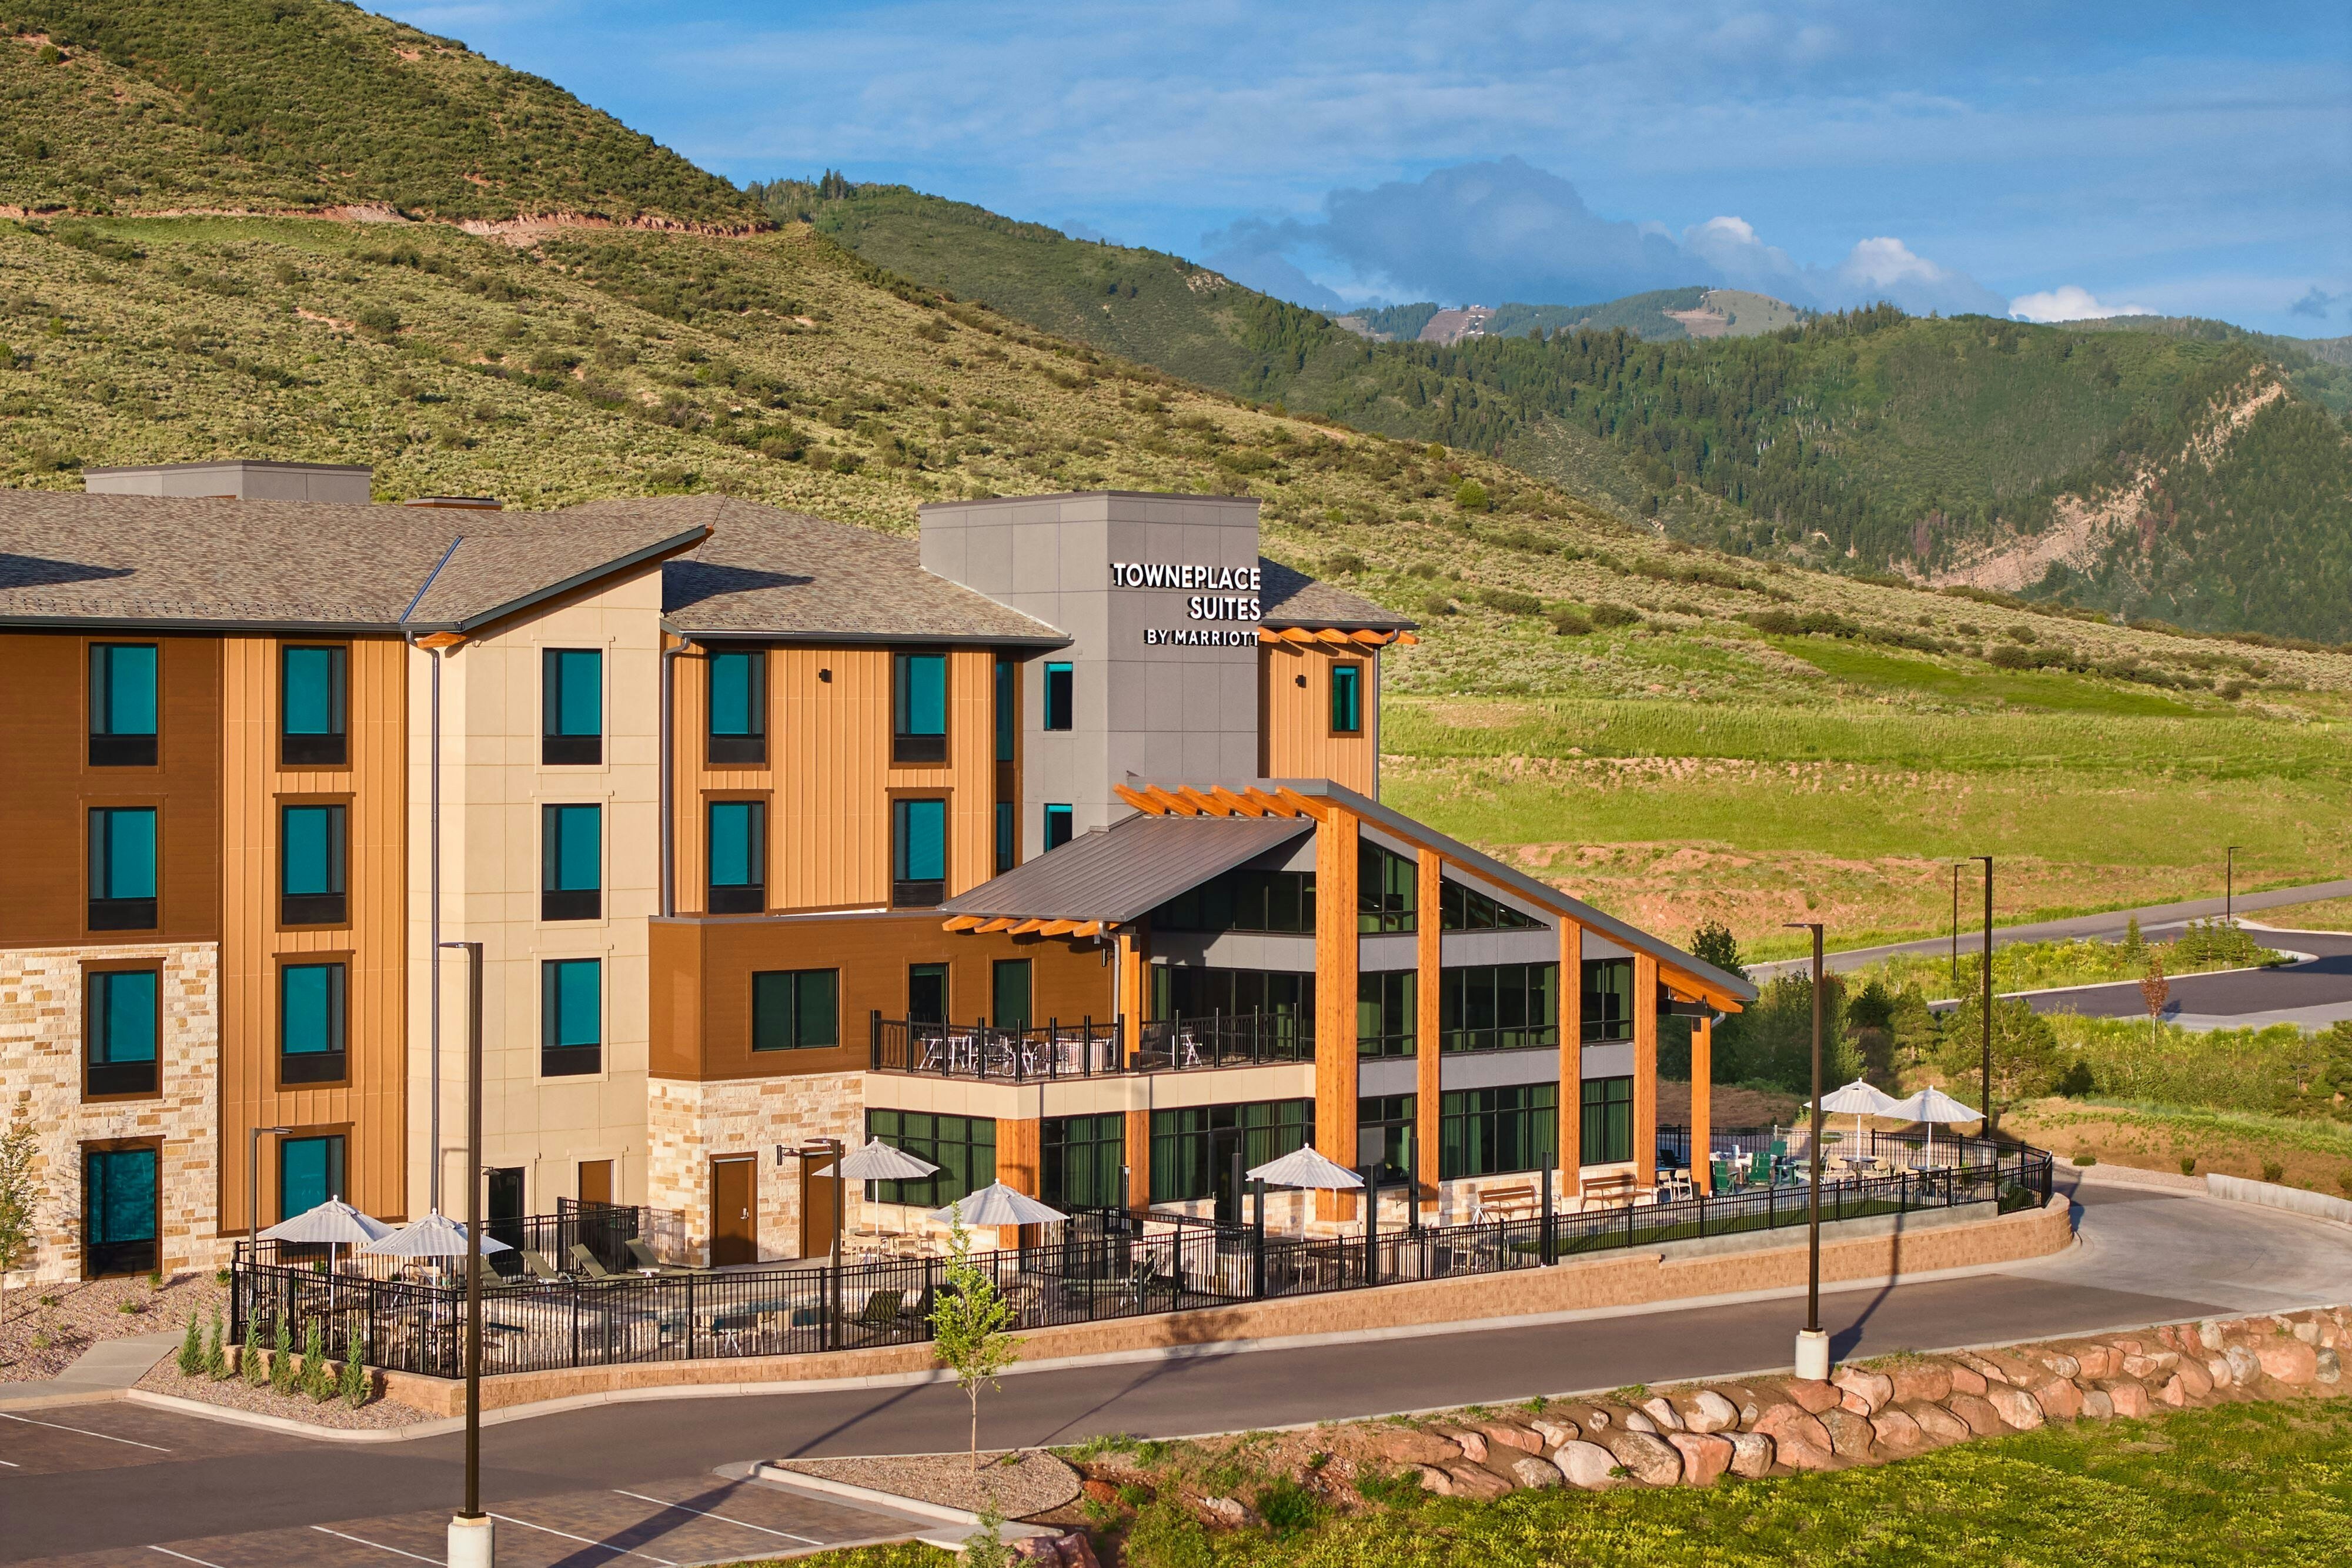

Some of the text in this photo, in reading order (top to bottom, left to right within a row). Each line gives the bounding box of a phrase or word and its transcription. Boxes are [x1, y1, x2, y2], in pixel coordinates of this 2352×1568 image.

[1113, 563, 1261, 590] TOWNEPLACE
[1190, 596, 1261, 621] SUITES
[1147, 628, 1261, 646] BY MARRIOTT
